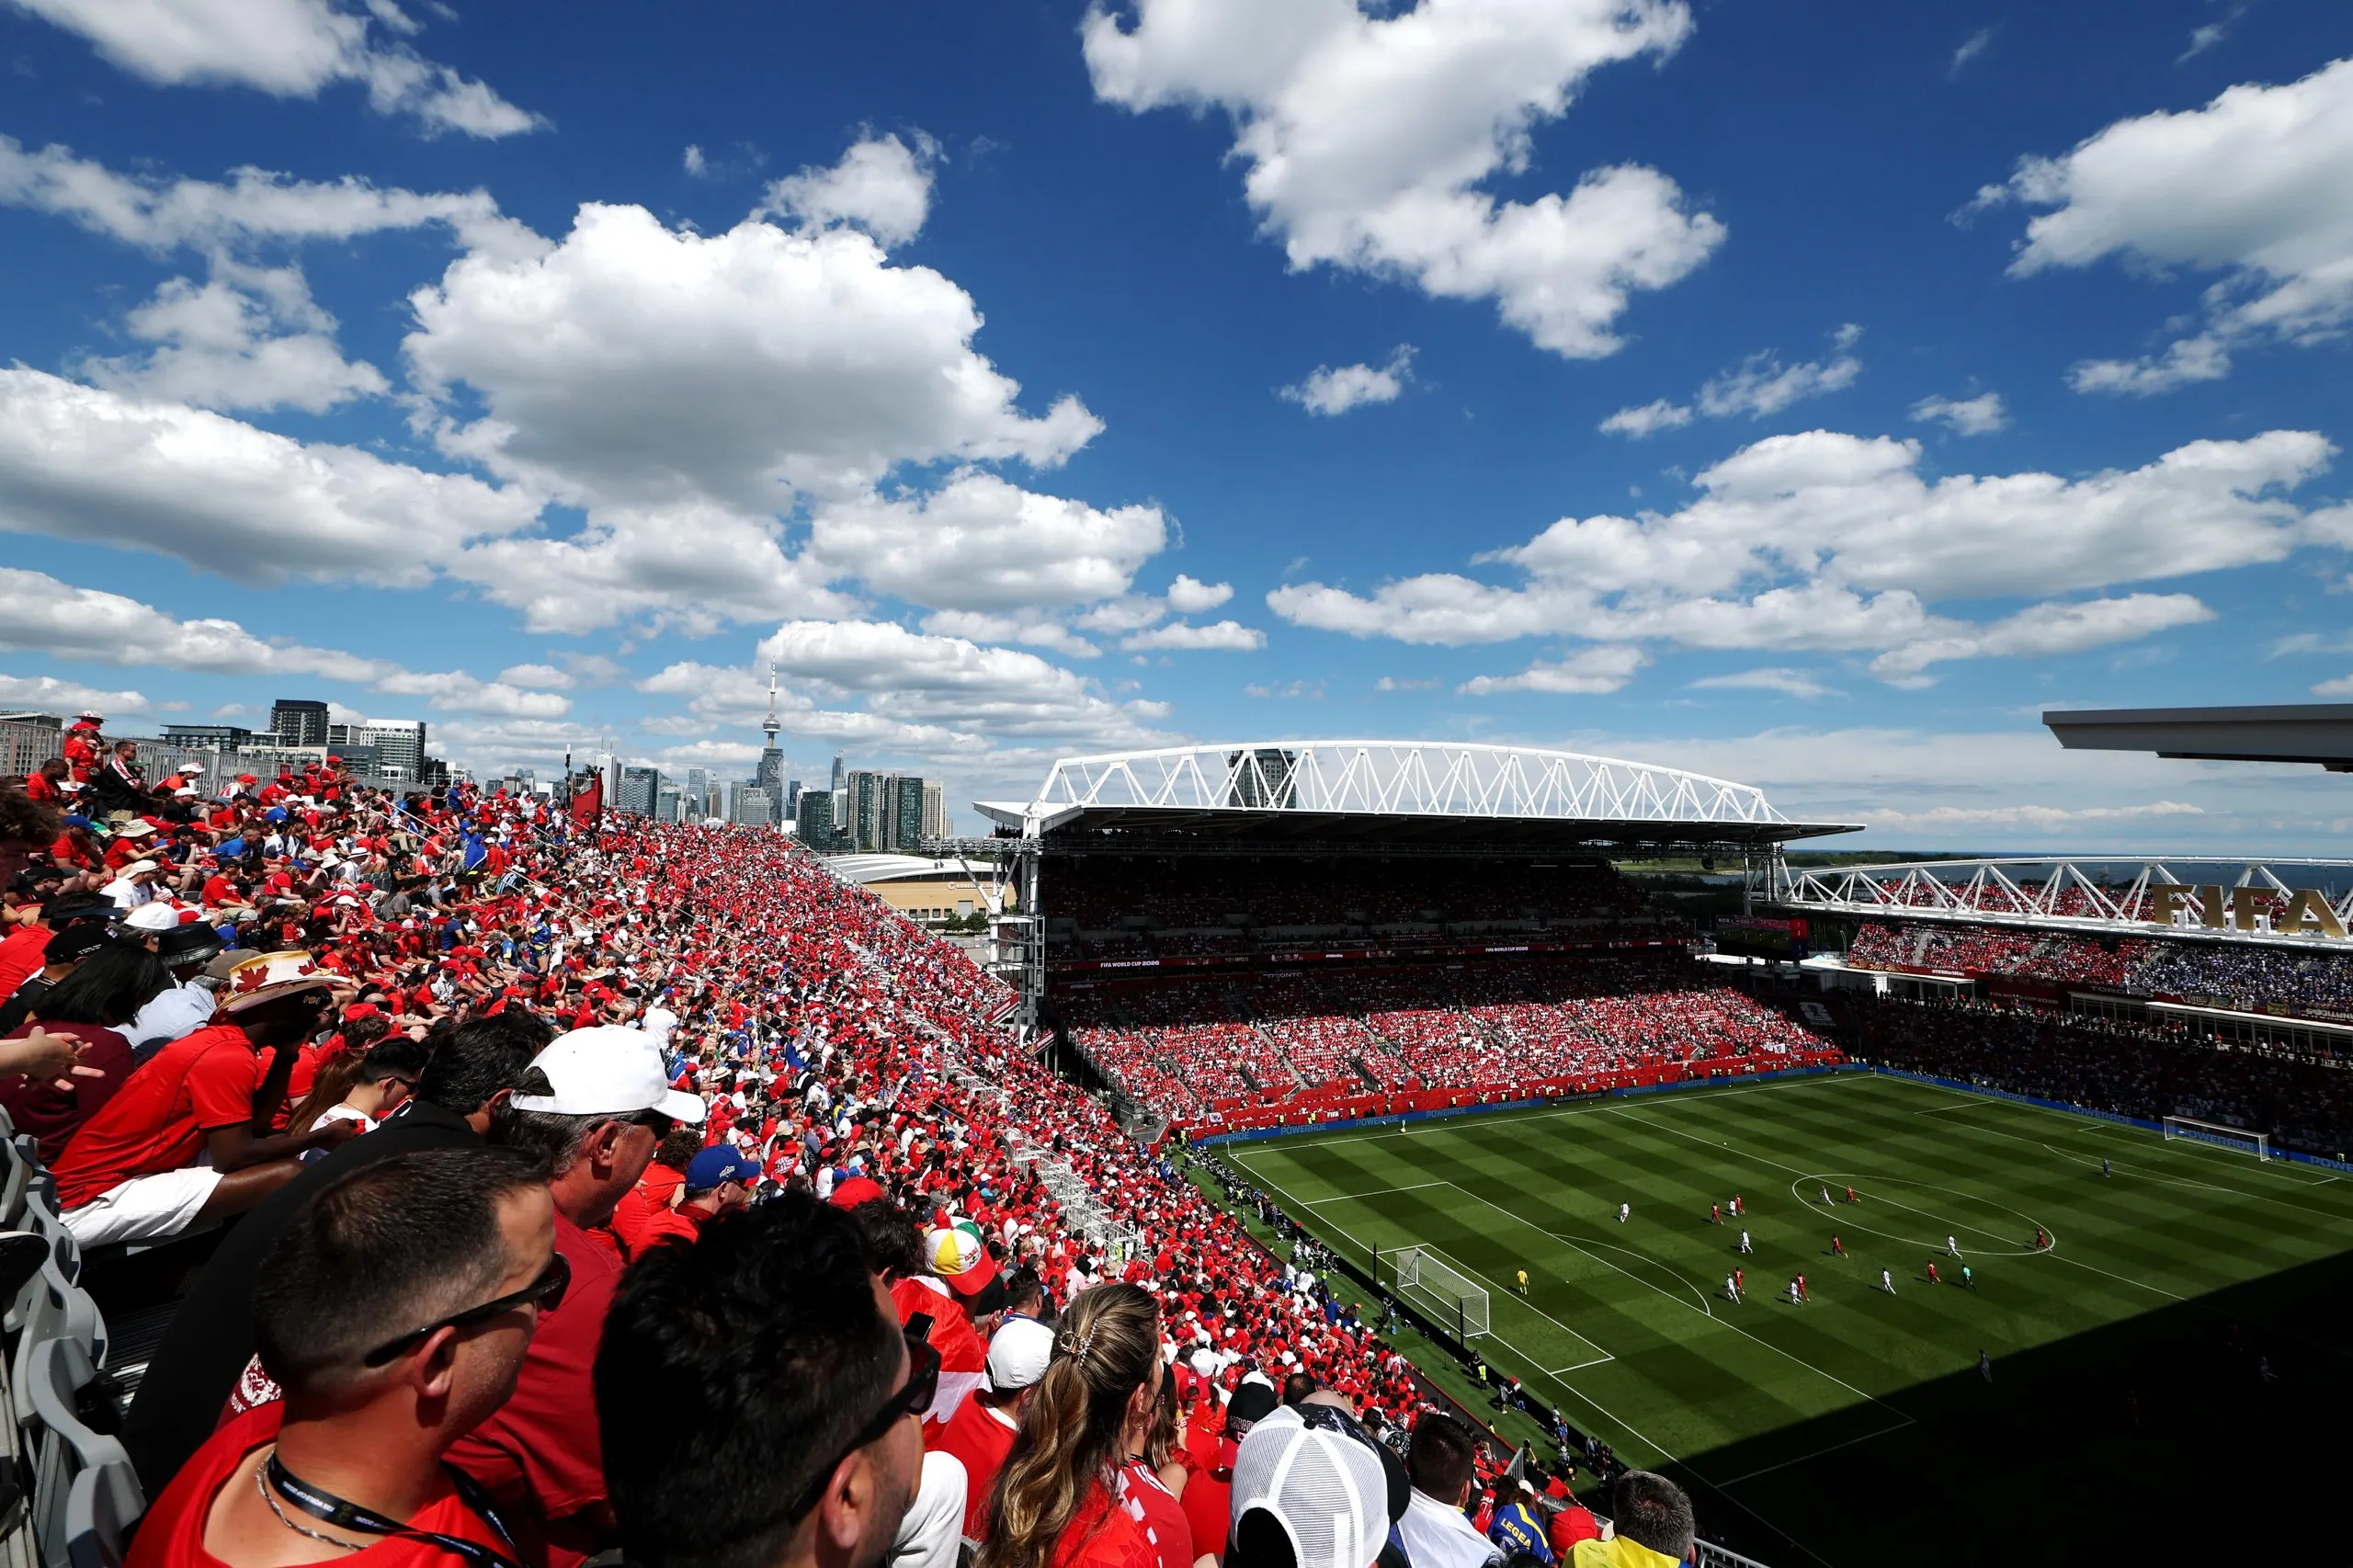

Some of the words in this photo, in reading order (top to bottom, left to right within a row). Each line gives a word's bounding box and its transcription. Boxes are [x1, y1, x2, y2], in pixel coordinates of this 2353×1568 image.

[2152, 883, 2347, 937] FIFA
[2089, 985, 2154, 998] TOROO
[1778, 1067, 1807, 1077] POWERADE
[1887, 1069, 1938, 1085] POWERADE
[1677, 1078, 1710, 1090] POWERADE
[1729, 1074, 1760, 1084] POWERADE
[1623, 1085, 1657, 1096] POWERADE
[1972, 1085, 2029, 1103] POWERADE
[1492, 1099, 1530, 1111] POWERADE
[1326, 1110, 1339, 1119] FIFA
[1426, 1107, 1467, 1119] POWERADE
[2068, 1104, 2133, 1125] POWERADE
[1356, 1113, 1399, 1128] POWERADE
[1280, 1123, 1326, 1136] POWERADE
[1204, 1131, 1250, 1146] POWERADE
[2179, 1128, 2254, 1152] POWERADE
[304, 1494, 324, 1507] WORLD
[322, 1502, 335, 1513] FIFA
[1500, 1517, 1532, 1548] LEGEA
